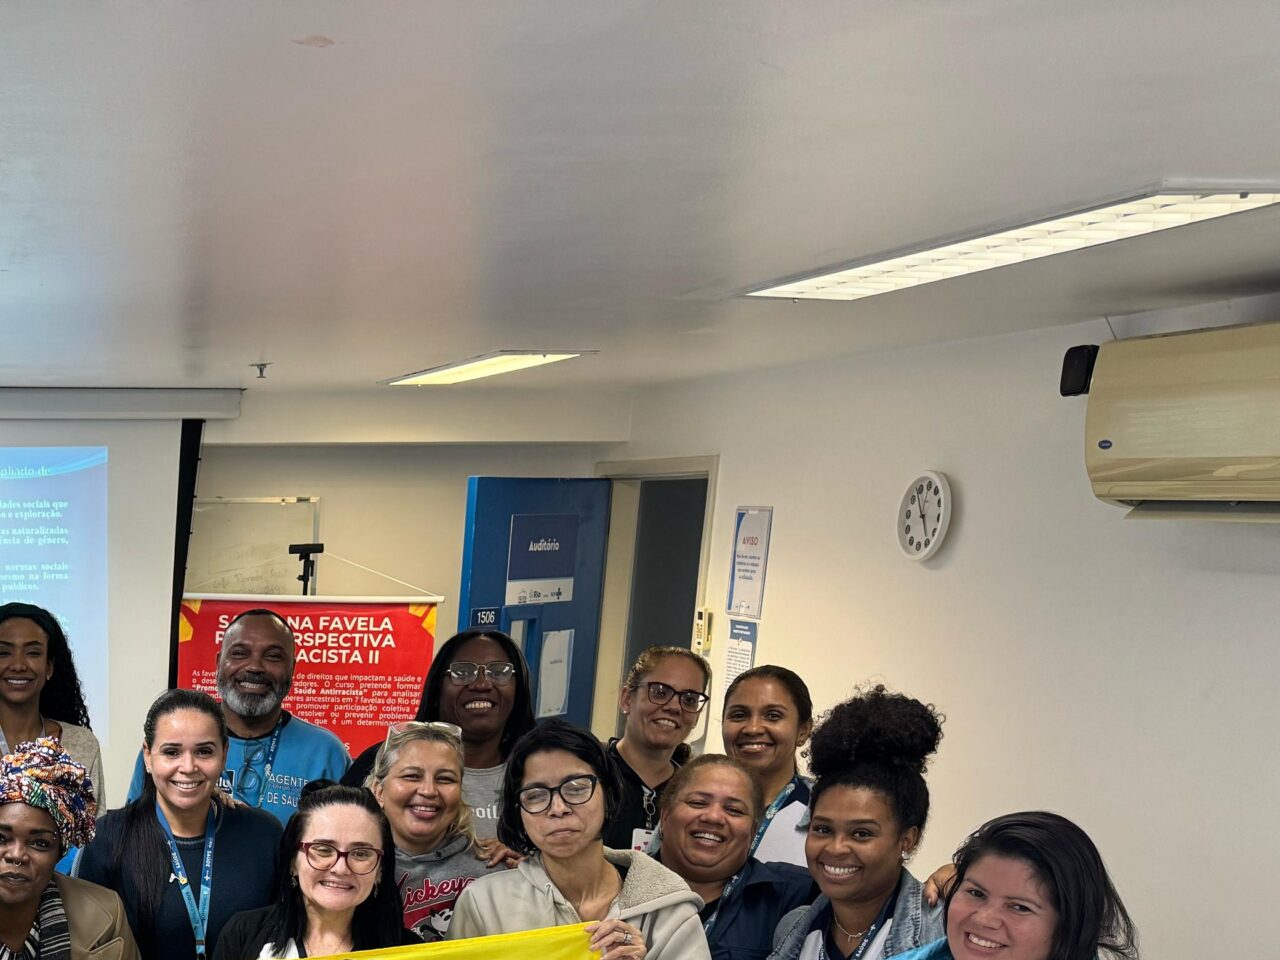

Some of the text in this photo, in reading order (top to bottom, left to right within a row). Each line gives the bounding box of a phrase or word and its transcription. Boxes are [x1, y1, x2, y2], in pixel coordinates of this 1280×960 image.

[23, 499, 51, 508] sociais
[52, 500, 68, 510] que
[11, 525, 68, 535] naturalizadas
[528, 538, 560, 552] Auditório
[742, 536, 758, 546] AVISO
[287, 615, 393, 631] NA FAVELA
[477, 611, 495, 624] 1506
[294, 632, 396, 648] RSPECTIVA
[296, 649, 380, 664] ACISTA II
[350, 674, 385, 682] impactam
[393, 674, 415, 682] saúde
[360, 681, 392, 689] pretende
[294, 686, 316, 694] Saúde
[392, 690, 421, 698] analisar
[360, 696, 385, 704] favelas
[410, 697, 420, 705] de
[296, 702, 329, 710] promover
[334, 703, 377, 712] participação
[344, 711, 374, 719] prevenir
[267, 792, 279, 804] DE
